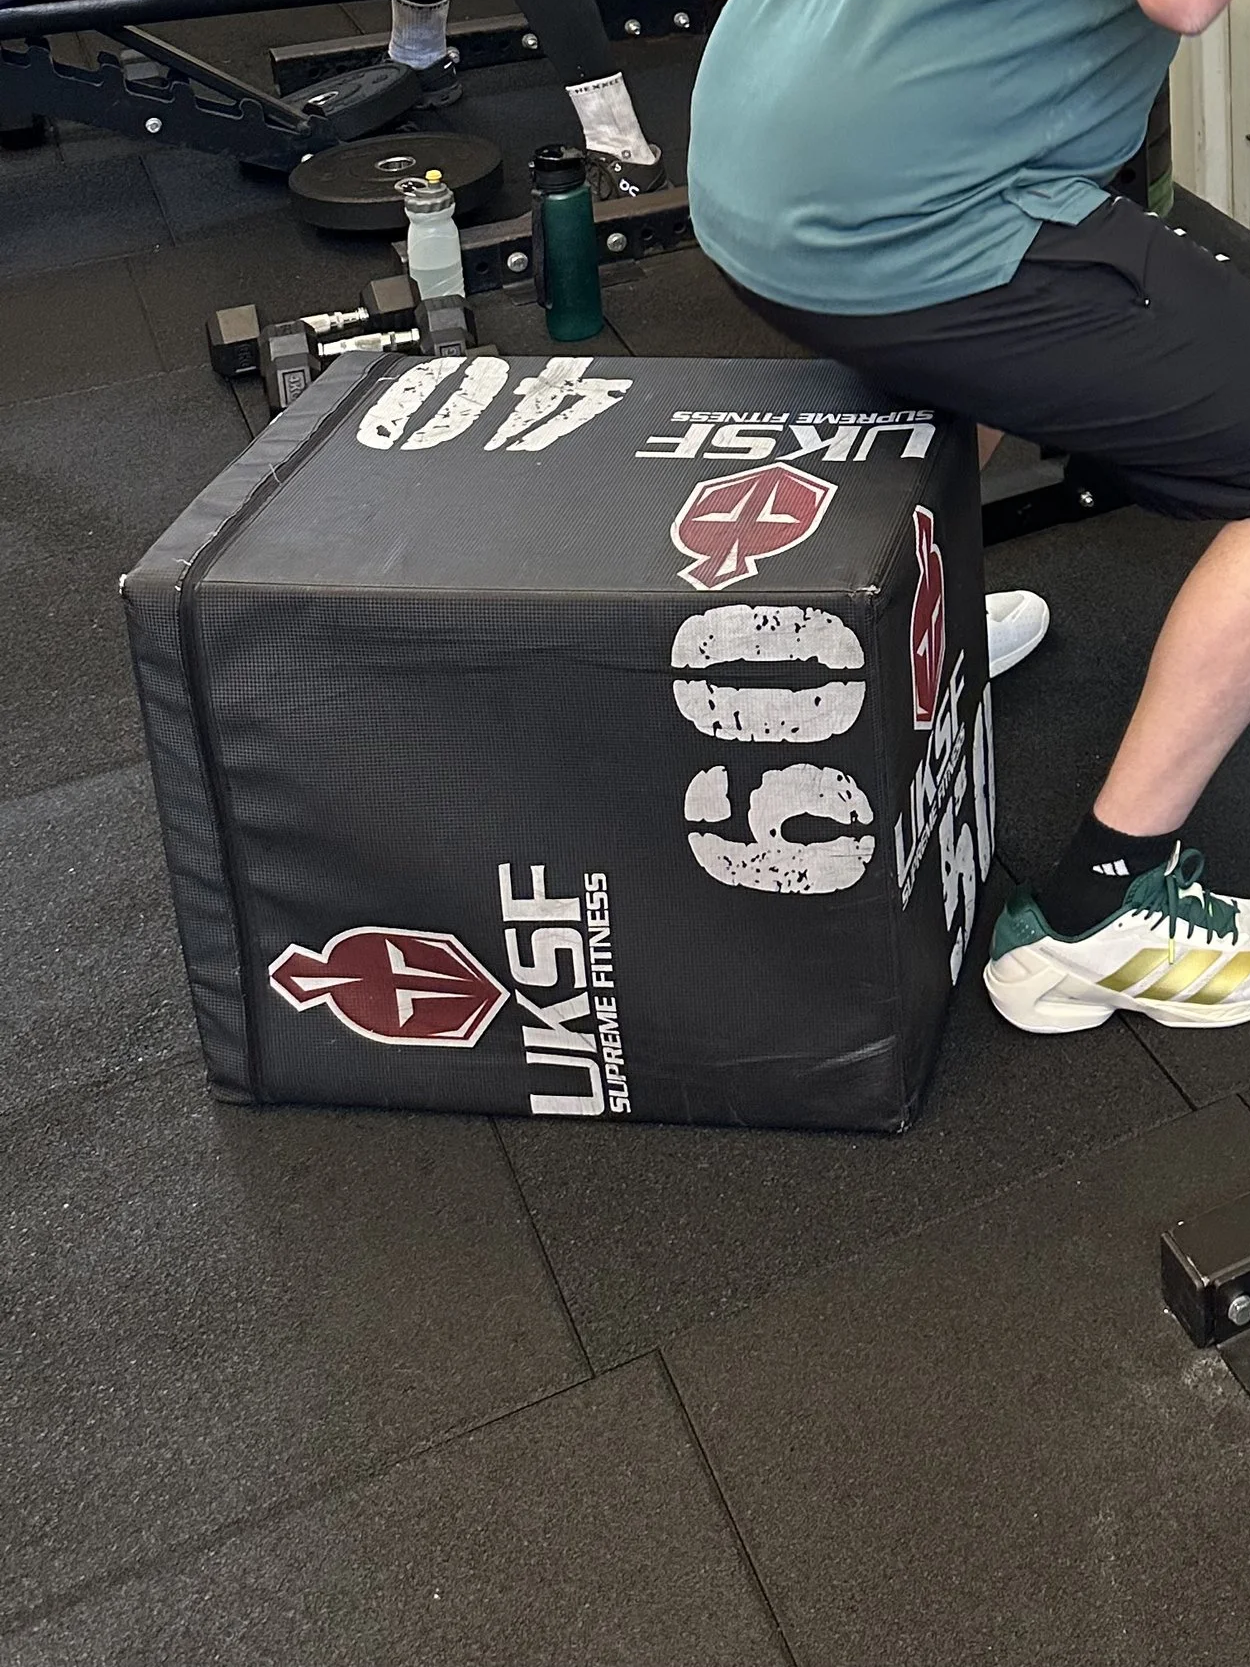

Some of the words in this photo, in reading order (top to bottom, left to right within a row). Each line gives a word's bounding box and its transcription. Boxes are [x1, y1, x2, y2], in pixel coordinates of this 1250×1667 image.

[357, 357, 634, 451] 40
[635, 422, 937, 462] UKSF
[671, 410, 790, 423] FITNESS
[796, 409, 936, 424] SUPREME
[671, 604, 876, 895] 60
[584, 872, 615, 989] FITNESS
[498, 862, 605, 1116] UKSF
[594, 995, 632, 1114] SUPREME
